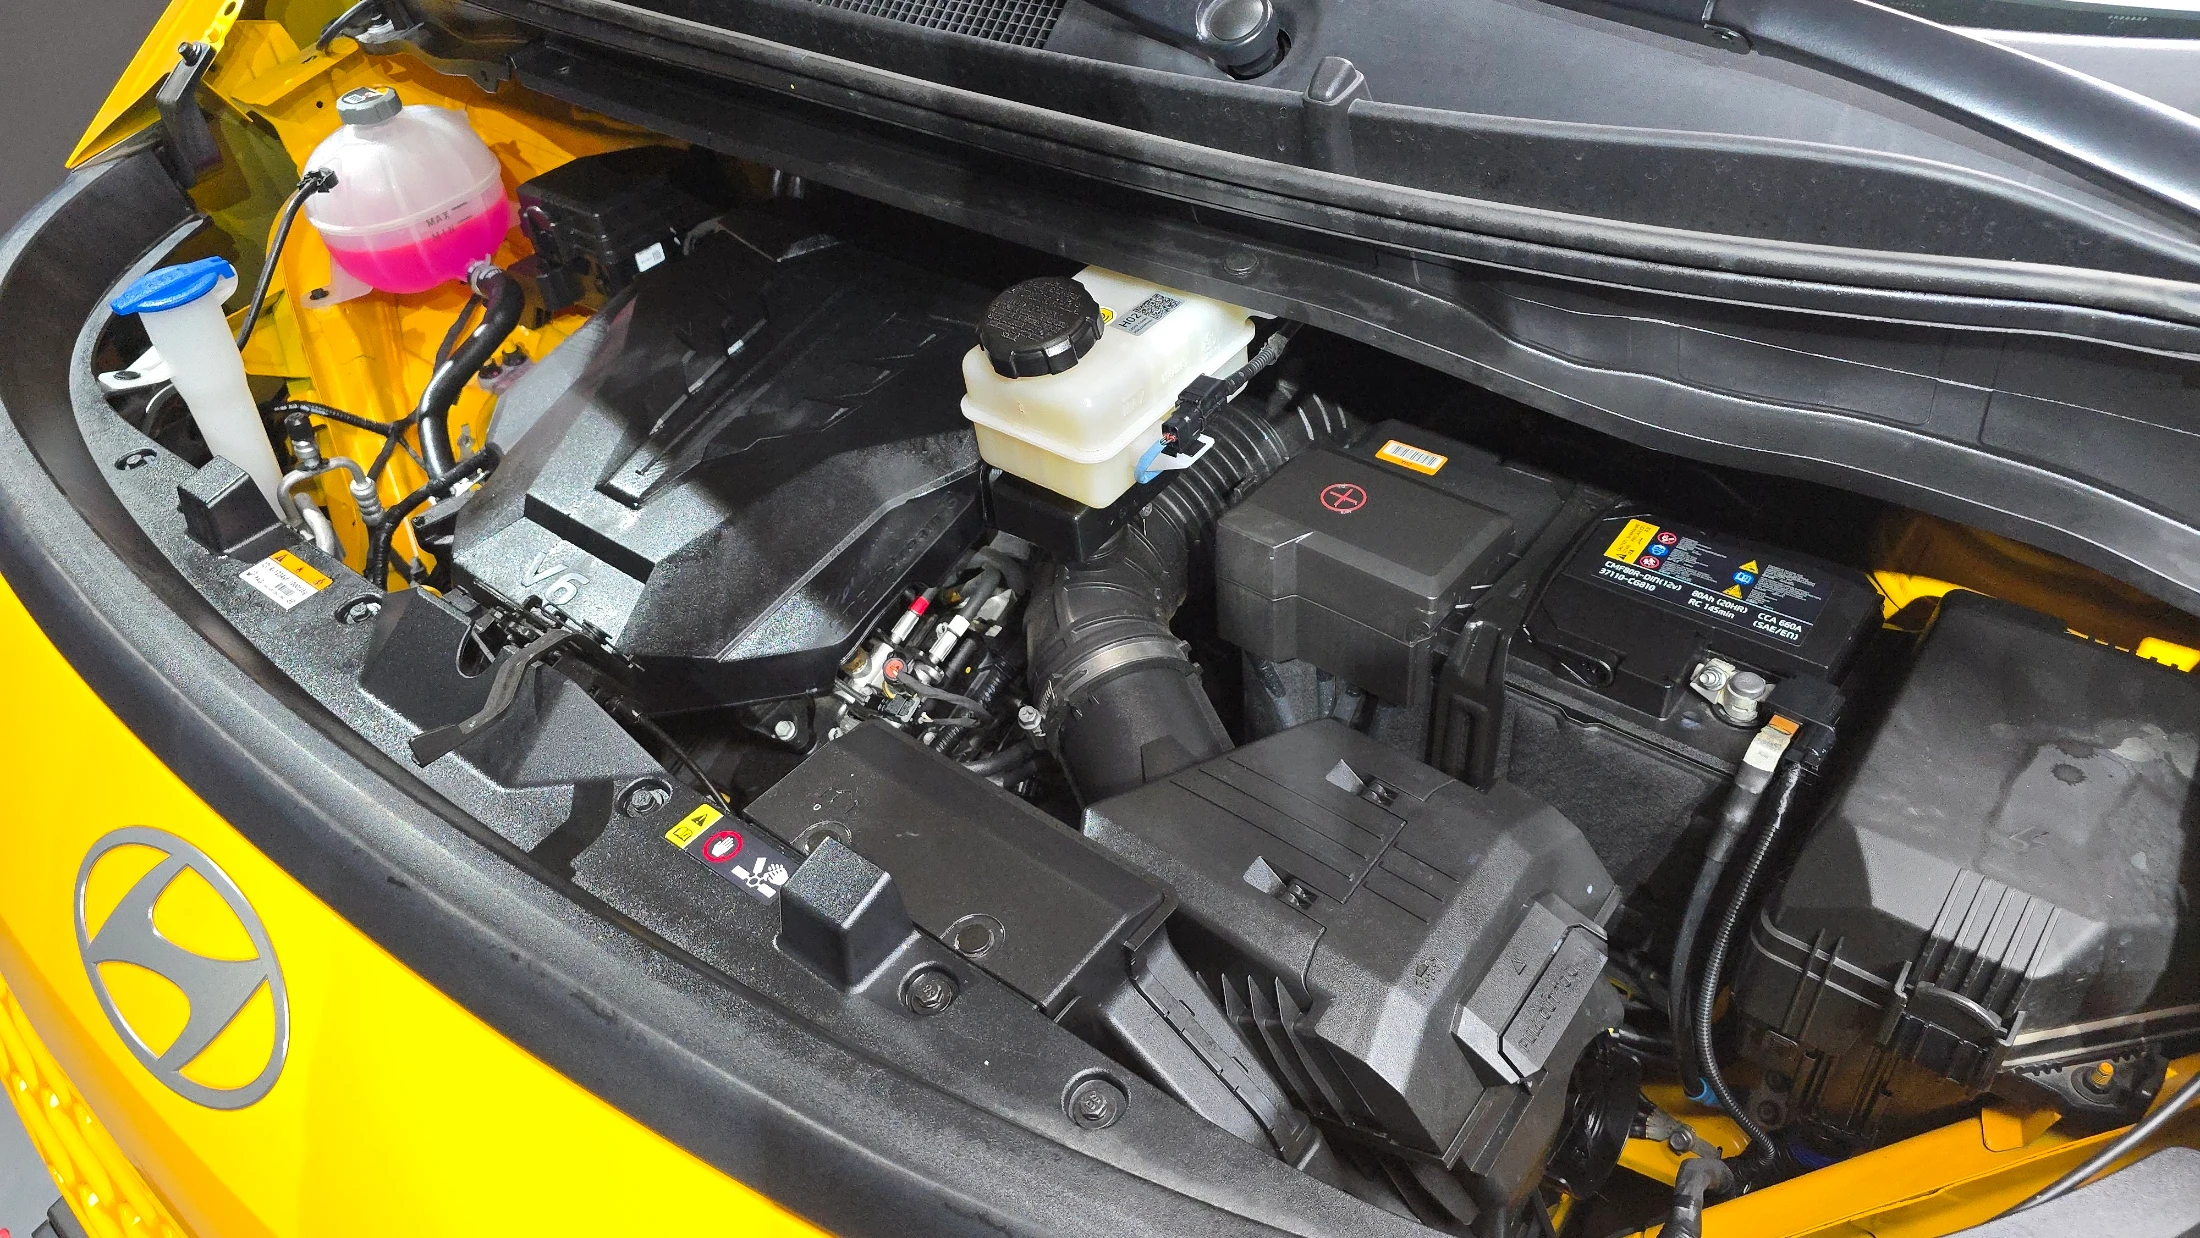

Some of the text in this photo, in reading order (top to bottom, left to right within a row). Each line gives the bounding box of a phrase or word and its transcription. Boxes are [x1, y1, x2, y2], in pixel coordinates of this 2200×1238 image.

[425, 210, 450, 227] MAX
[431, 224, 455, 241] MIN
[1118, 312, 1142, 328] H02
[520, 550, 591, 606] V6
[1687, 598, 1736, 620] RC 145min
[1691, 589, 1749, 614] 80Ah (20HR)
[1757, 612, 1802, 633] CCA 660A
